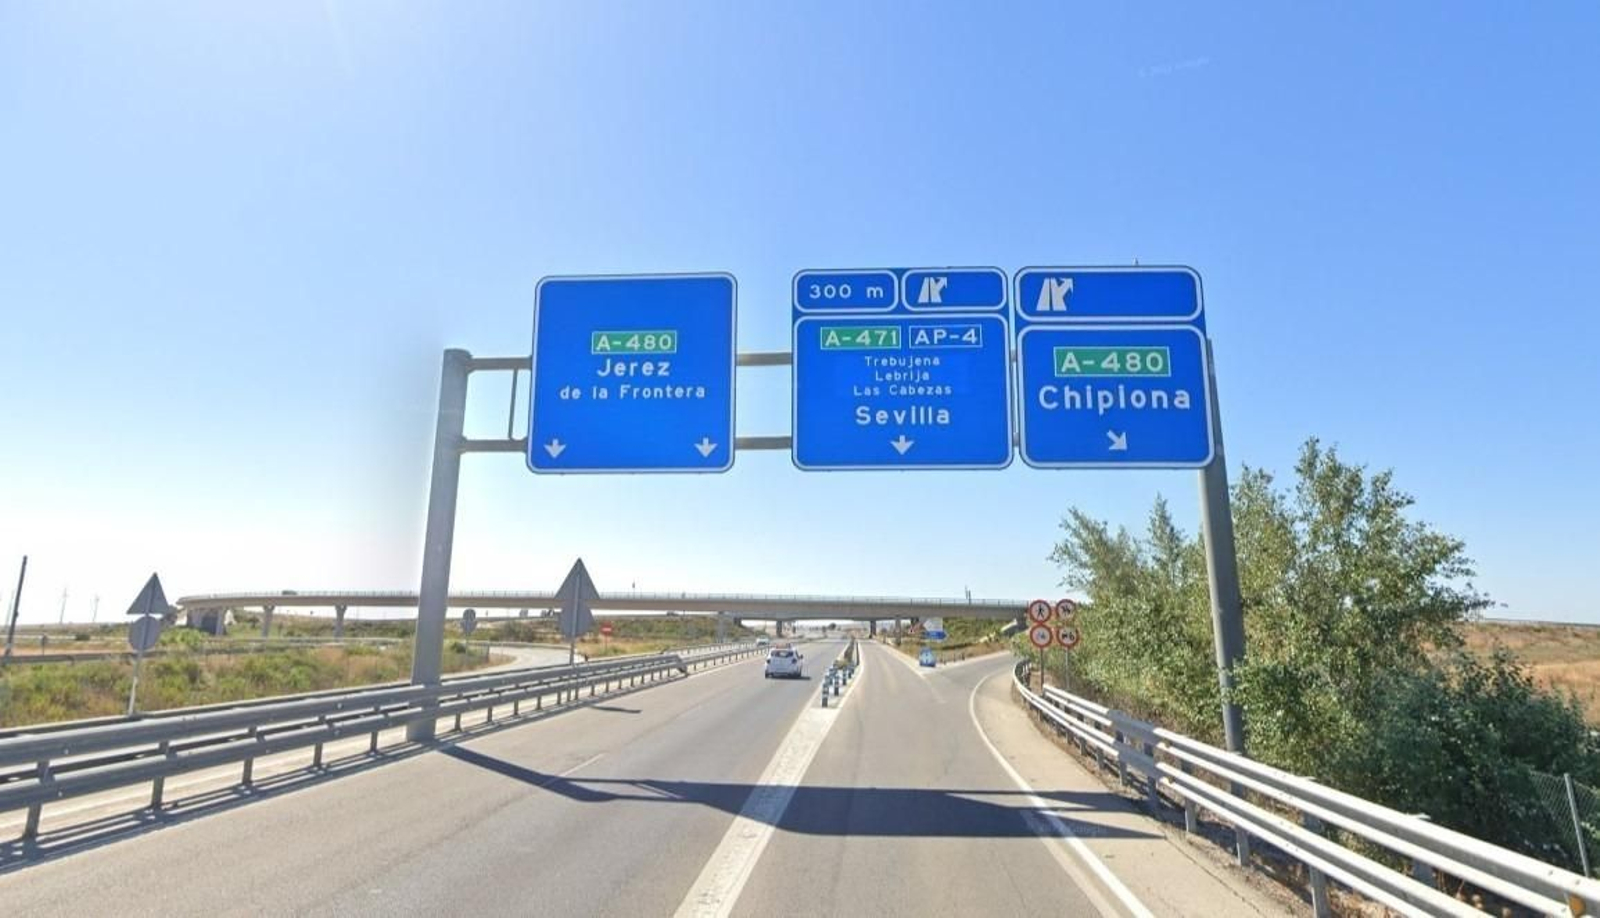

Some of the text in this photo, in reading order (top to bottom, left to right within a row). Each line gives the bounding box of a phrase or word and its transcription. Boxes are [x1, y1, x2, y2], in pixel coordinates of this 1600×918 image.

[809, 284, 884, 299] 300 m
[595, 334, 672, 351] A-480
[824, 328, 978, 347] A-471 AP-4
[596, 358, 671, 377] Jerez
[864, 355, 940, 369] Trebujena
[1060, 351, 1164, 373] A-480
[875, 370, 930, 382] Lebrija
[559, 384, 706, 399] de la Frontera
[853, 384, 952, 396] Las Cabezas
[1038, 384, 1191, 416] Chipiona
[855, 405, 951, 425] Sevilla
